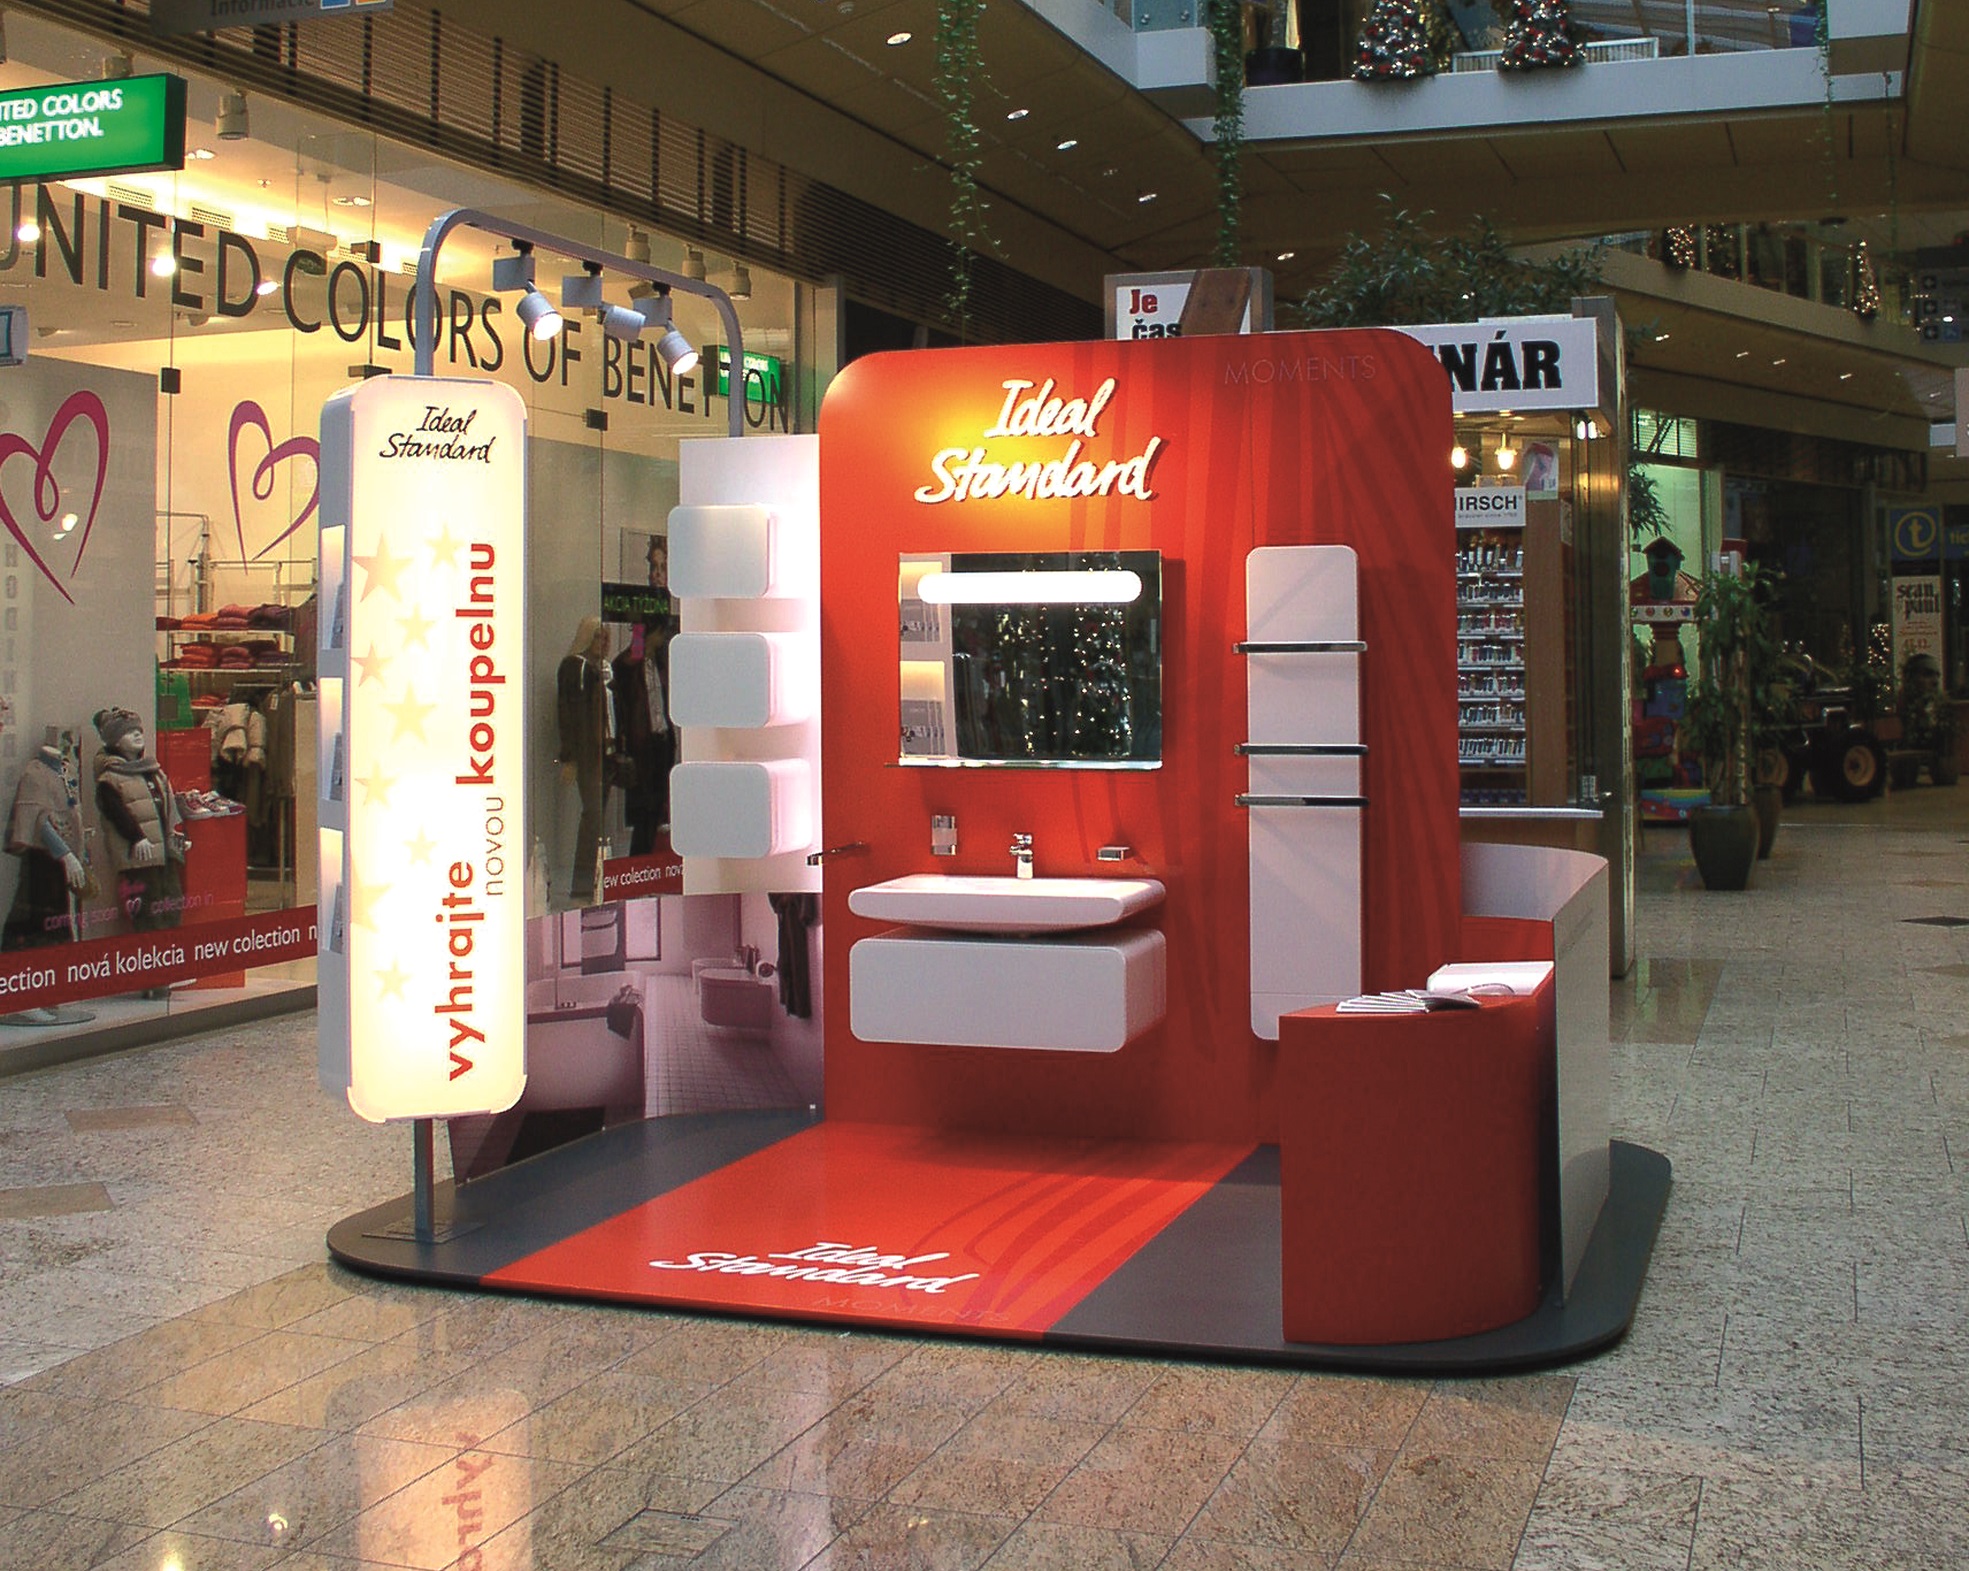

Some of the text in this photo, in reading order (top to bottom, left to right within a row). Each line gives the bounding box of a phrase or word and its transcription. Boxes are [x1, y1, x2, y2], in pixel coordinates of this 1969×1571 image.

[42, 88, 123, 117] COLORS
[1129, 288, 1158, 315] Je
[283, 249, 503, 373] COLORS
[523, 320, 582, 386] OF
[604, 333, 789, 434] BENEON
[1428, 330, 1563, 393] NÁR
[1224, 355, 1377, 385] MOMENTS
[416, 405, 477, 436] Ideal
[984, 377, 1117, 438] Ideal
[379, 433, 496, 464] Standard
[914, 436, 1163, 503] Standard
[1454, 495, 1518, 512] IRSCH
[456, 542, 506, 785] koupelnu
[486, 796, 505, 897] novou
[67, 952, 111, 983] nová
[116, 943, 185, 974] kolekcia
[195, 938, 229, 961] new
[233, 925, 301, 953] colection
[434, 860, 485, 1081] vyhrajte
[649, 1252, 980, 1293] Standard
[769, 1242, 951, 1270] Ideal
